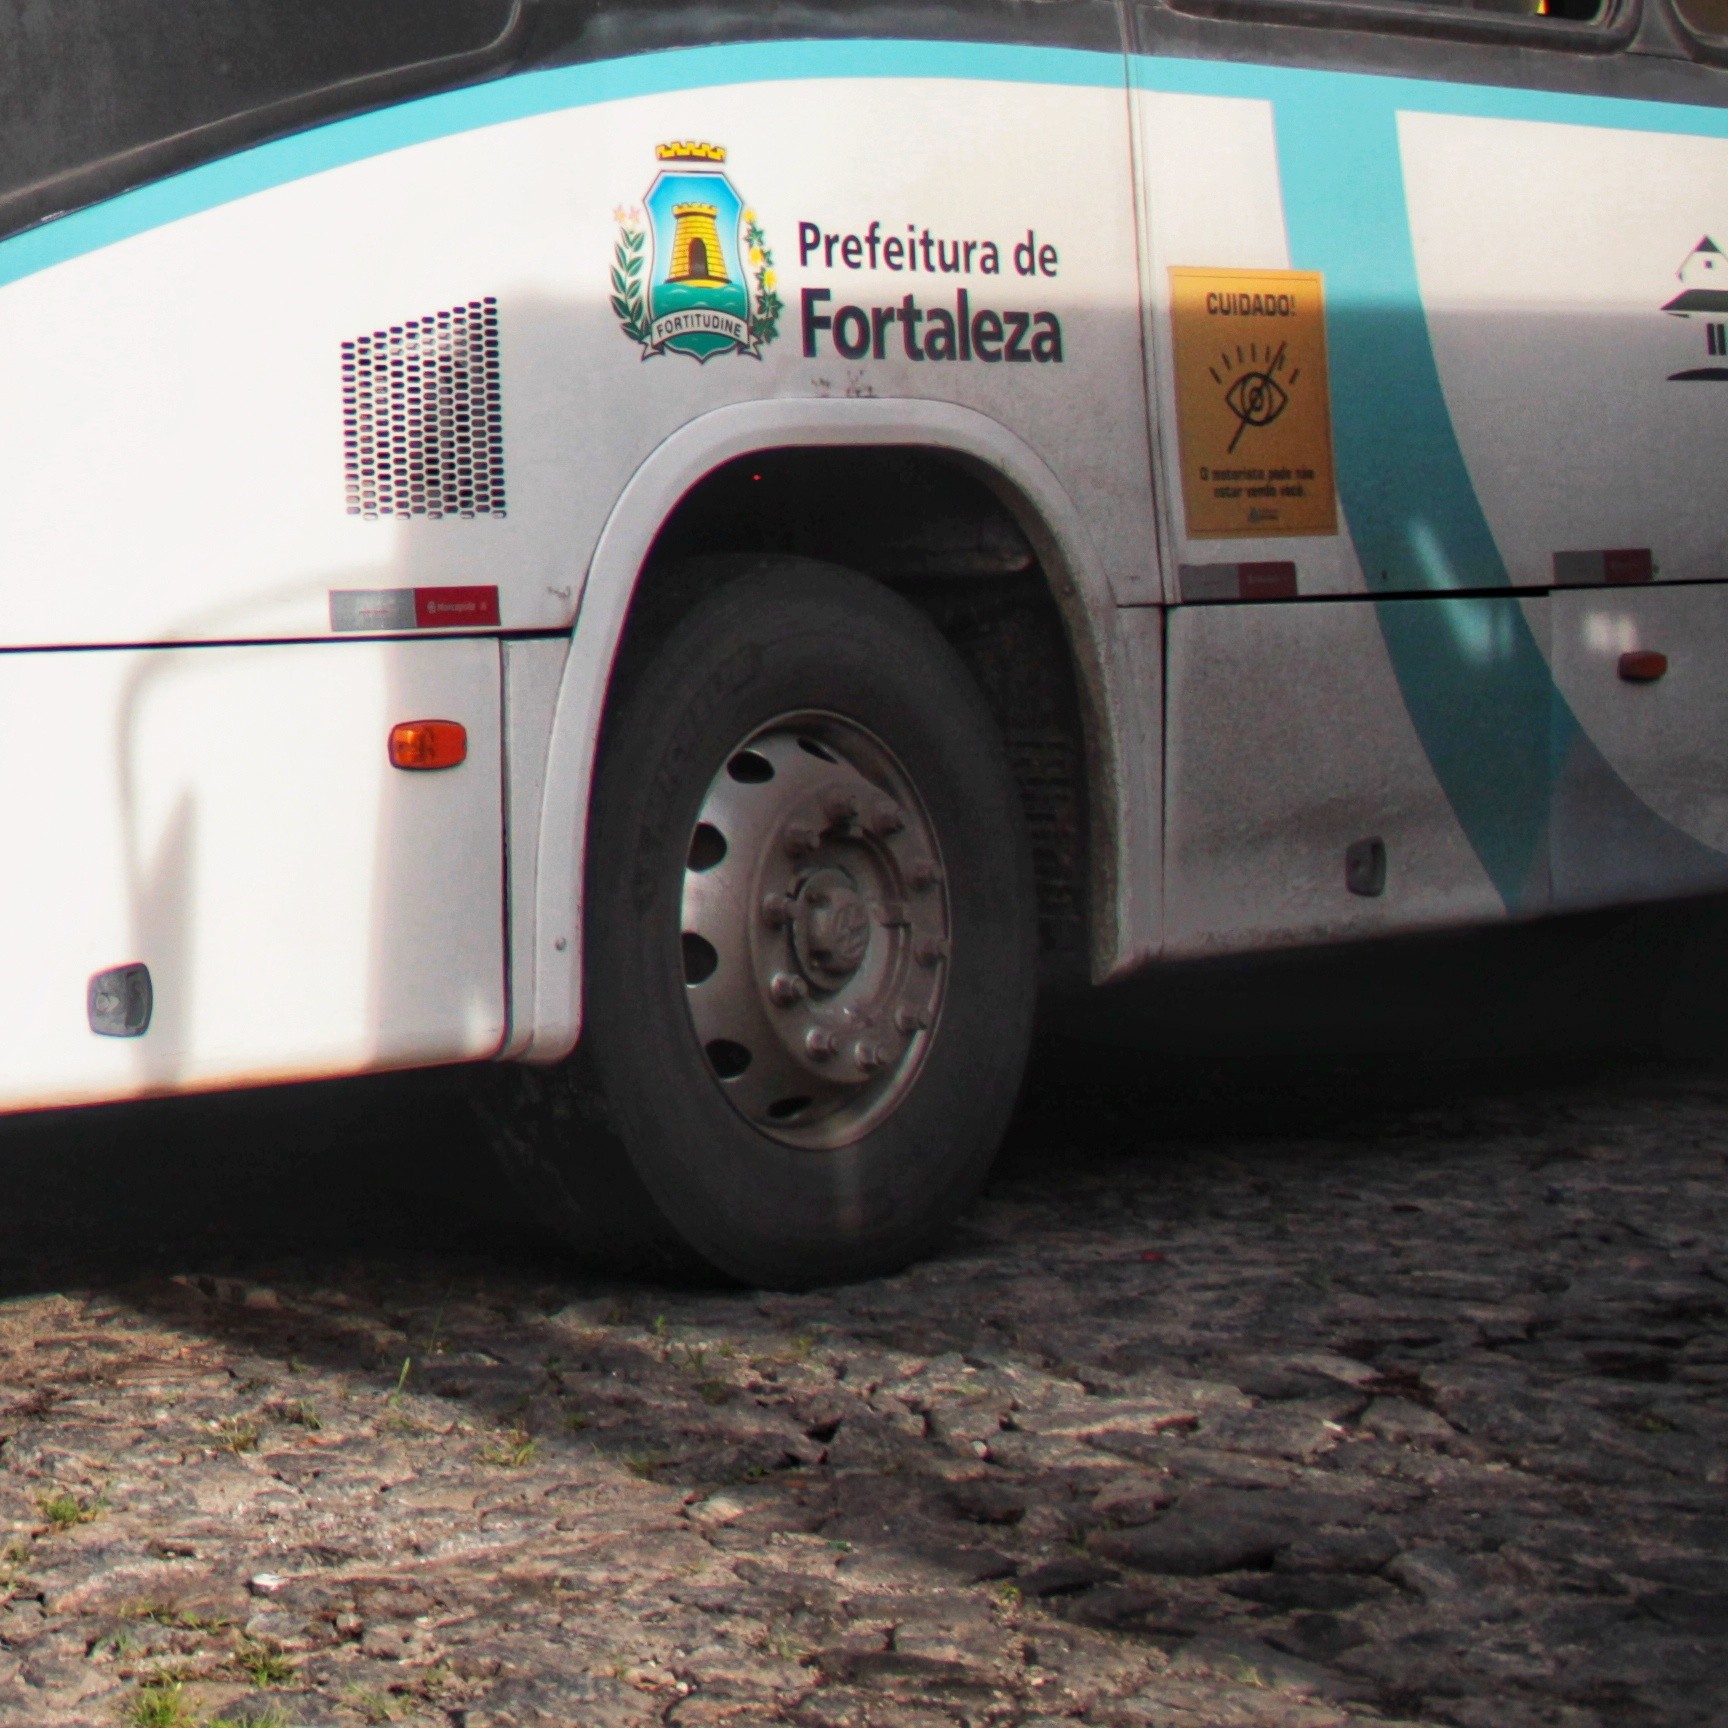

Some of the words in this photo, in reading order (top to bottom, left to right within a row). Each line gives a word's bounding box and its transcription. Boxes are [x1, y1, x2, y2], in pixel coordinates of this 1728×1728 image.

[798, 220, 999, 274] Prefeitura
[1013, 229, 1058, 278] de
[801, 287, 1063, 364] Fortaleza
[1205, 292, 1296, 317] CUIDADO!
[655, 313, 742, 340] FORTITUDINE
